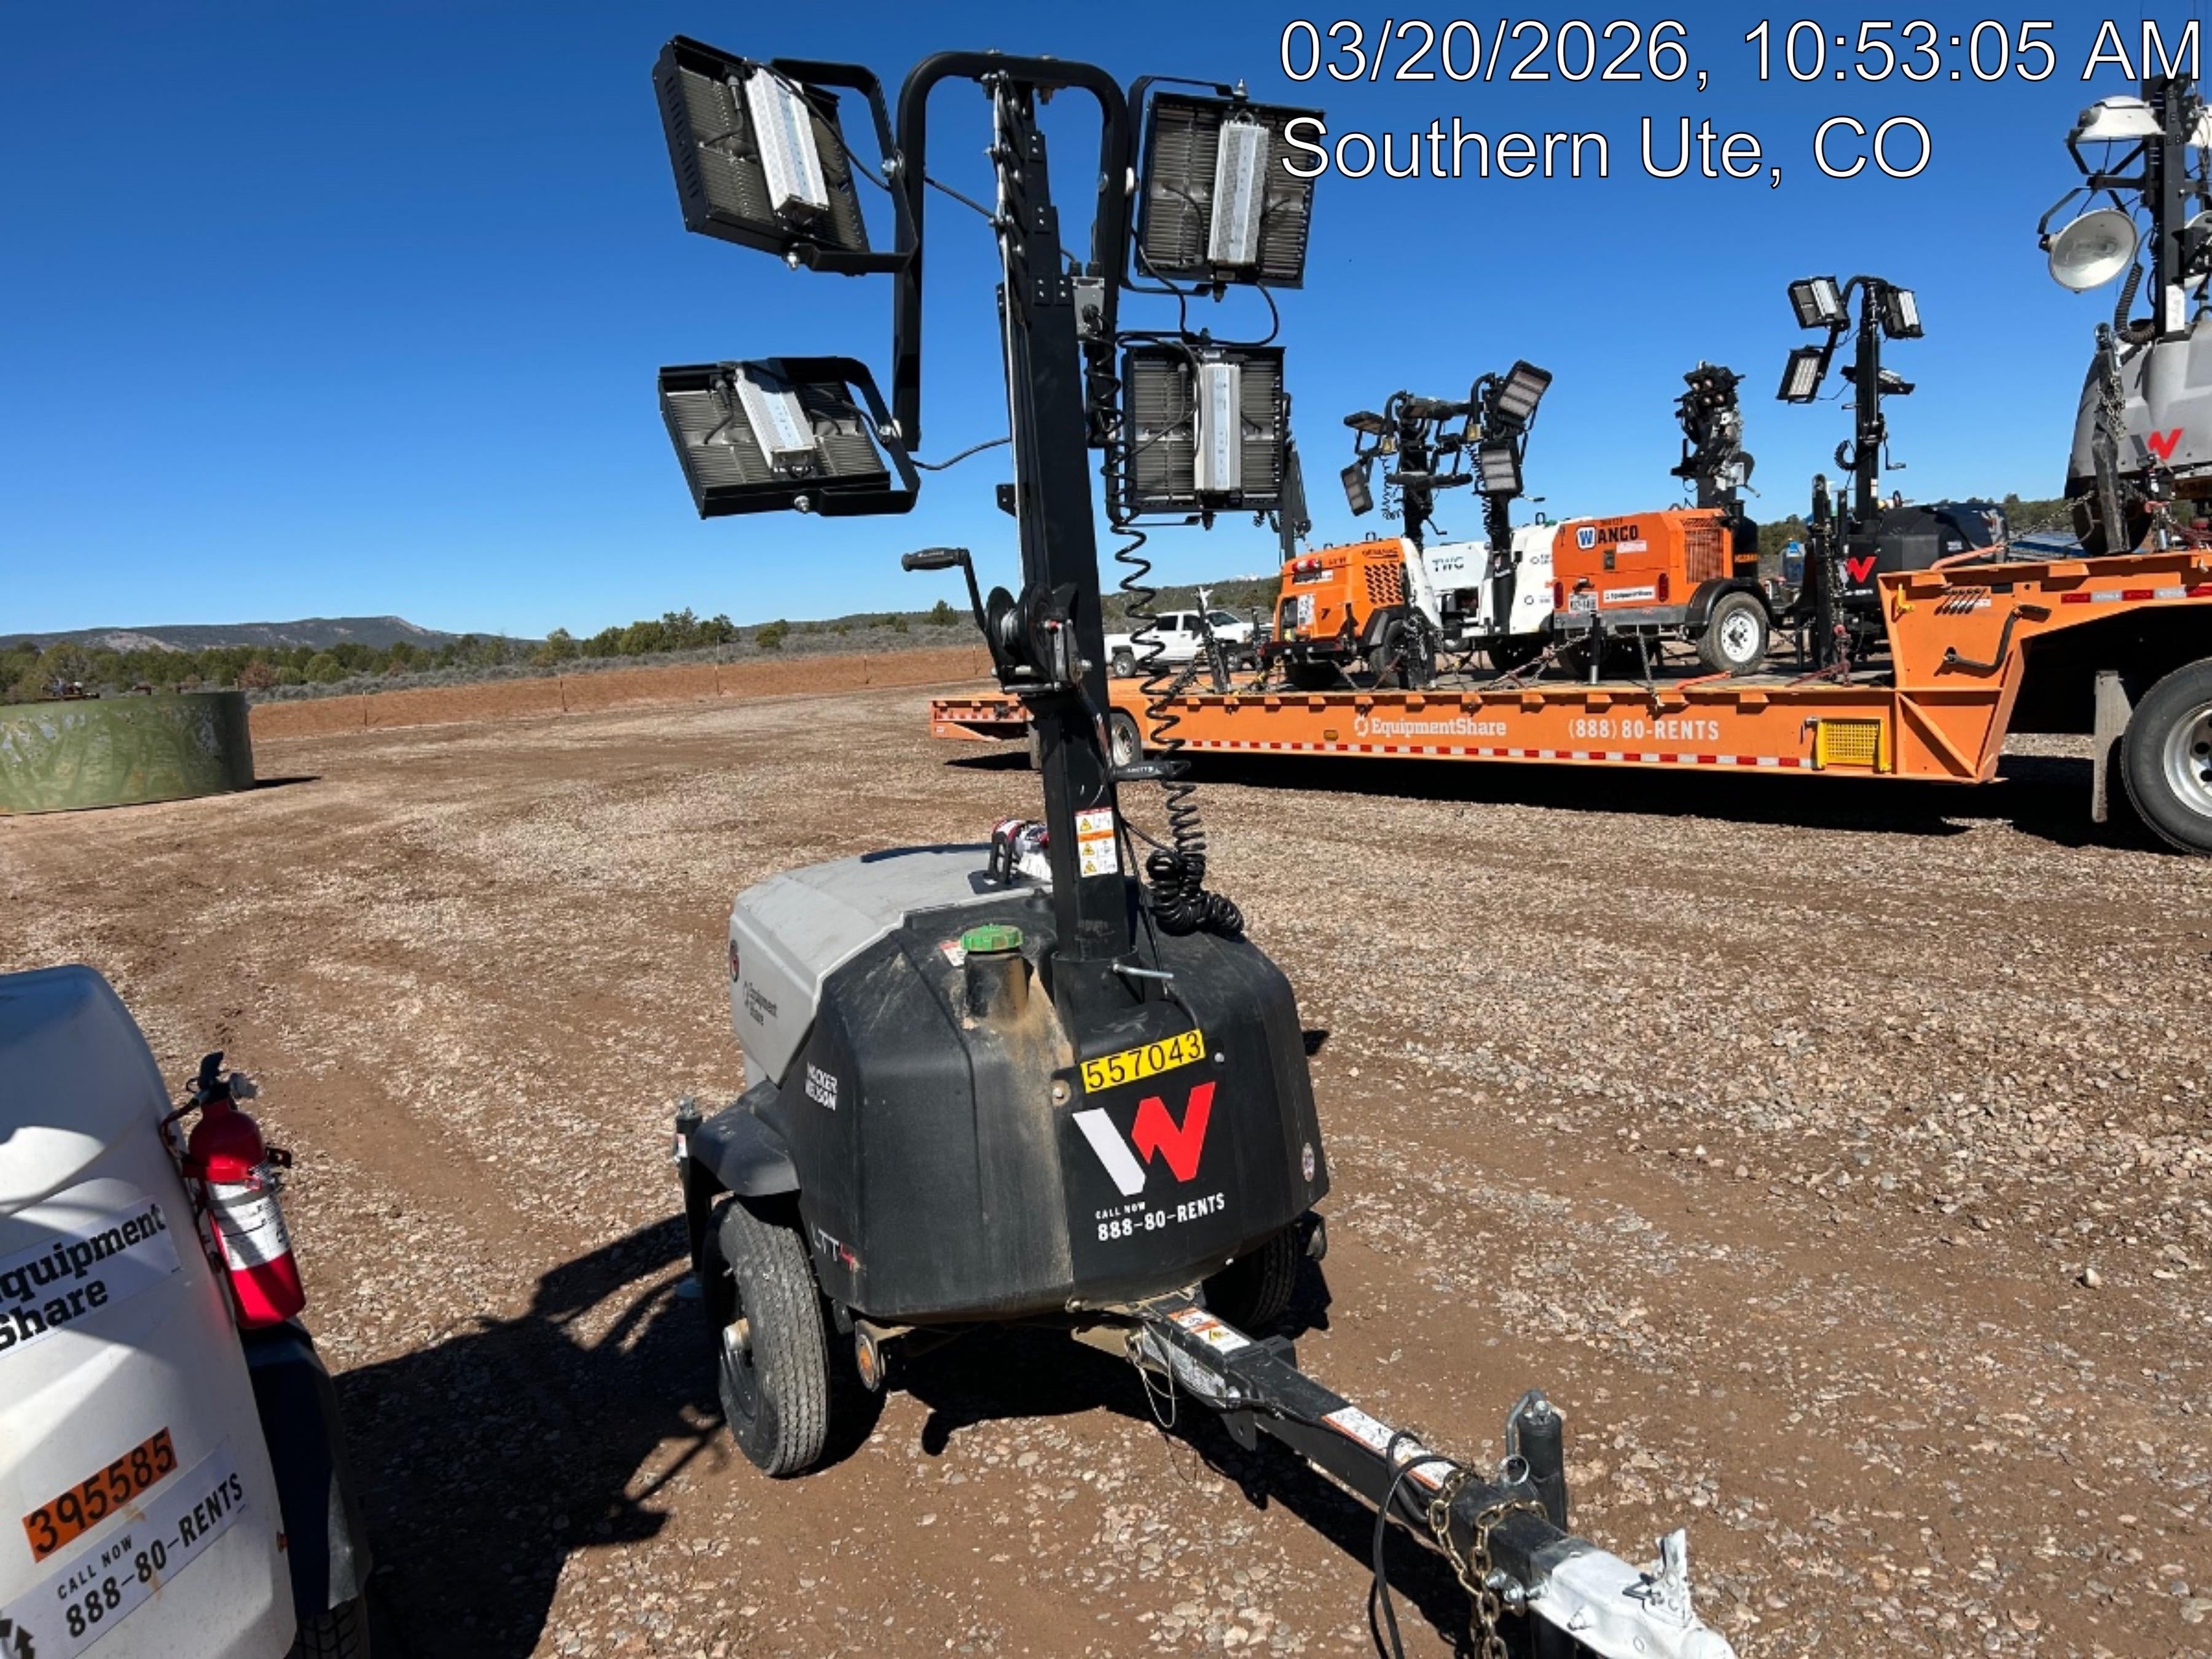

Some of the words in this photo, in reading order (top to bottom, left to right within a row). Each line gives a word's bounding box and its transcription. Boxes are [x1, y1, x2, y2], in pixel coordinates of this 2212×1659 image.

[1576, 525, 1638, 549] WANCO
[1371, 717, 1507, 737] EquipmentShare
[1568, 718, 1618, 739] (888)
[1621, 719, 1719, 740] 80-RENTS
[1086, 1032, 1202, 1089] 557043
[1096, 1208, 1121, 1219] CALL
[1124, 1202, 1146, 1213] NOW
[1097, 1193, 1225, 1241] 888-80-RENTS
[0, 1203, 166, 1303] quipment
[0, 1279, 108, 1351] Share
[28, 1430, 175, 1553] 395585
[58, 1563, 96, 1601] CALL
[101, 1535, 133, 1566] NOW
[66, 1473, 243, 1637] 888-80-RENTS
